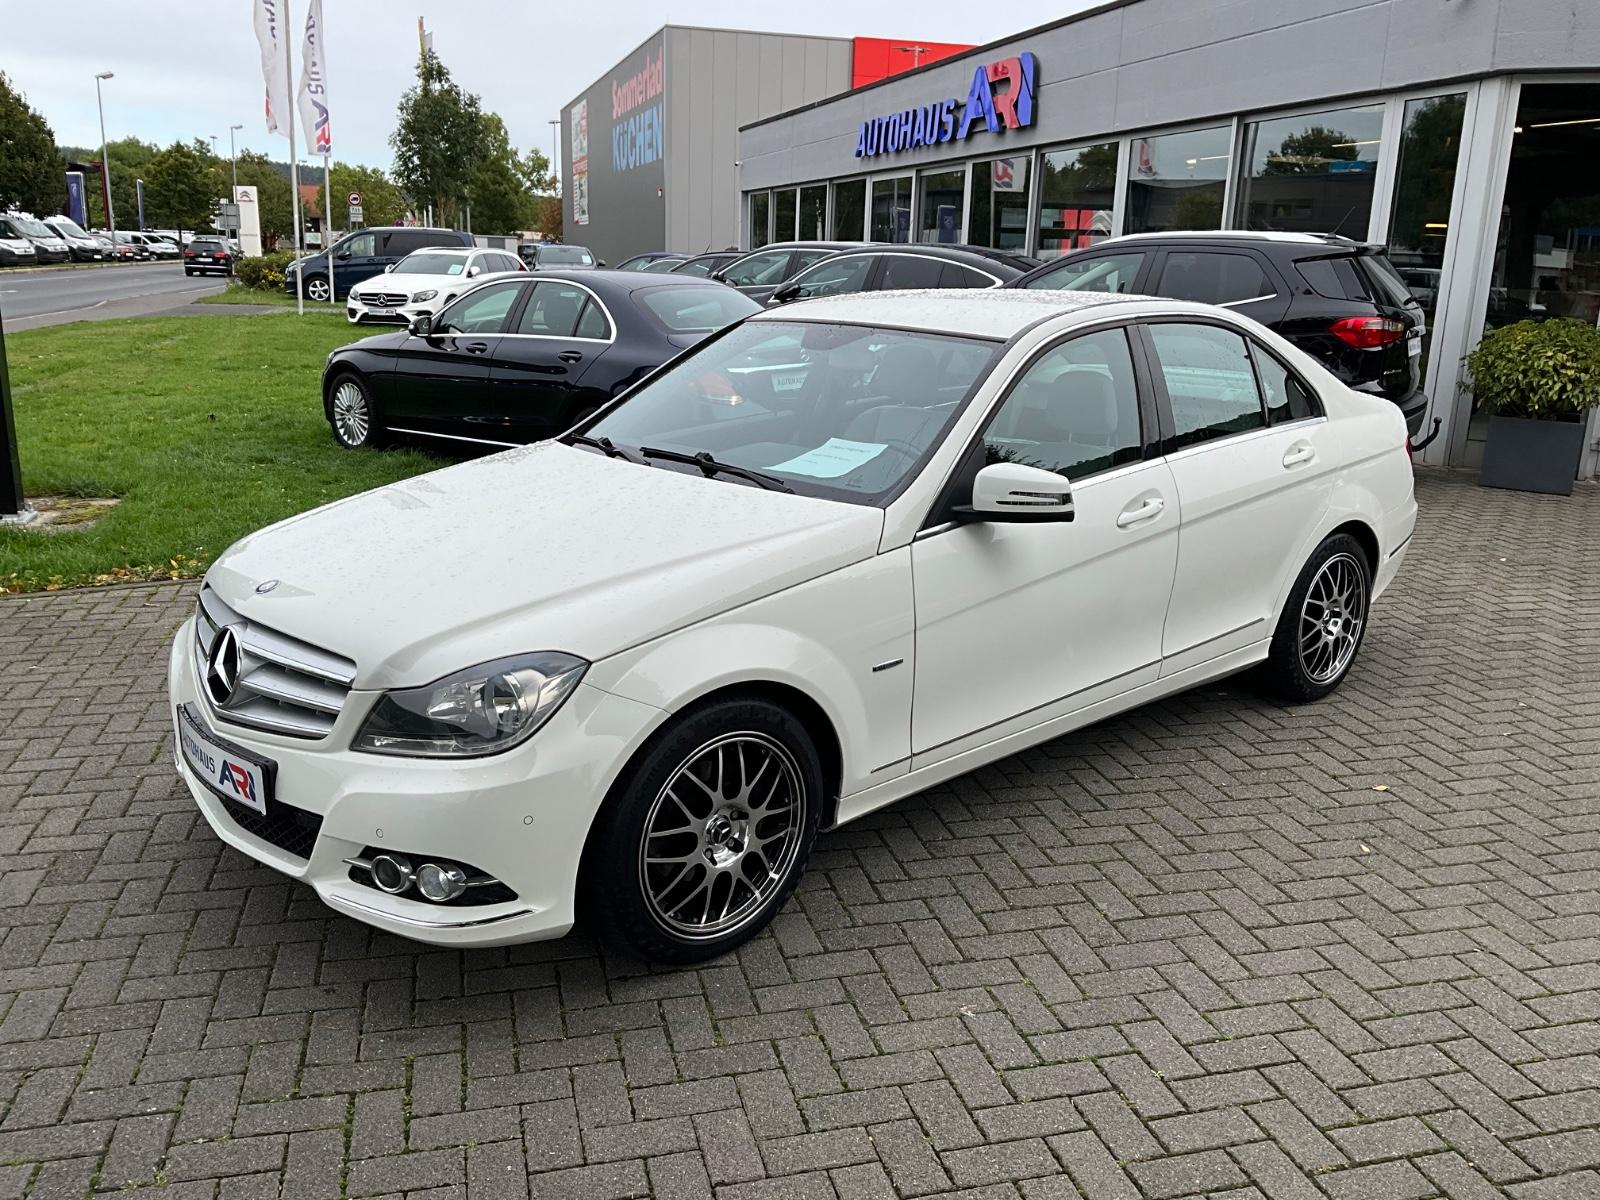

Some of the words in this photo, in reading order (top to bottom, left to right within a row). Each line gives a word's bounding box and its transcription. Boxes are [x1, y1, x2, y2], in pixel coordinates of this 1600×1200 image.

[611, 47, 663, 120] Sommerlad
[855, 97, 957, 158] AUTOHAUS
[956, 52, 1034, 139] ARI
[613, 103, 663, 175] KÜCHEN
[219, 760, 256, 803] ARI
